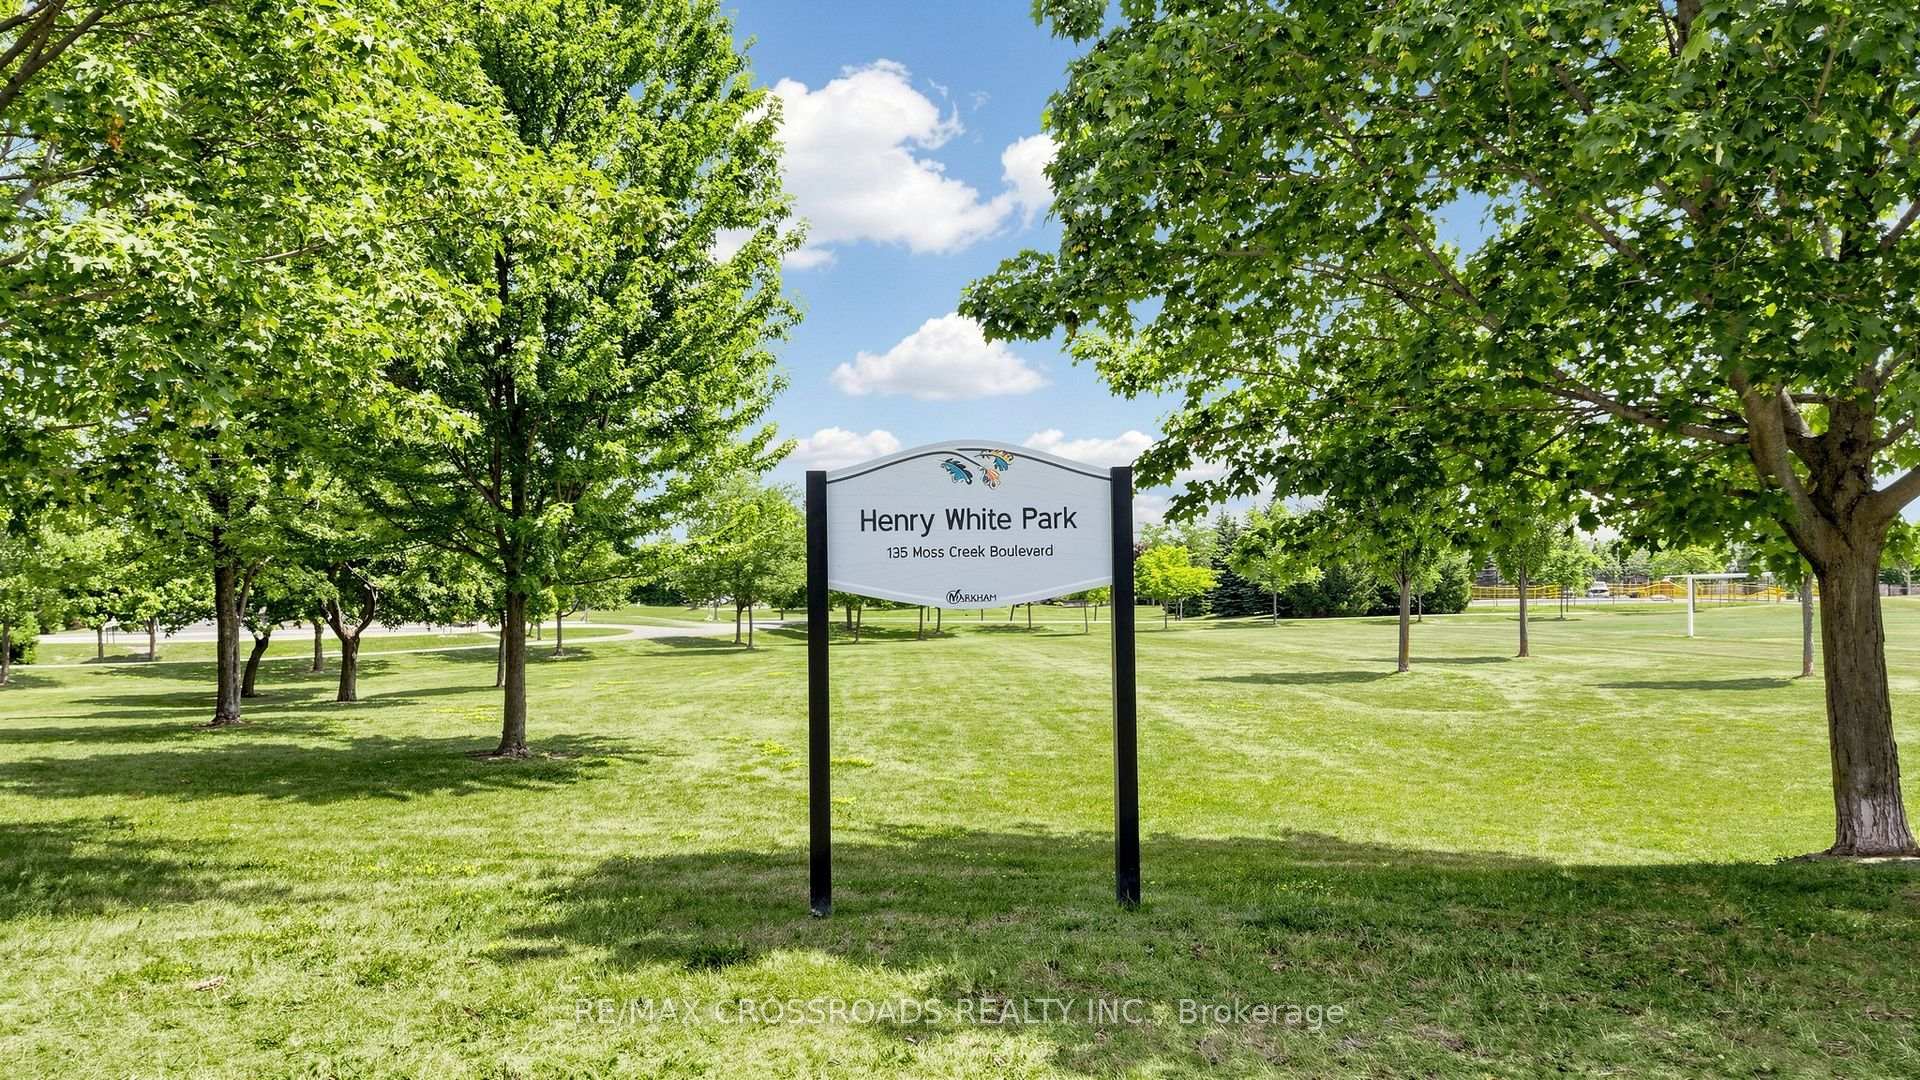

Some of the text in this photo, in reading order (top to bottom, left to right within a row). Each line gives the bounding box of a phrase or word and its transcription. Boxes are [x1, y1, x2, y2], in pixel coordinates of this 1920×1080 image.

[860, 506, 1078, 537] Henry White Park
[887, 544, 1054, 559] 135 Moss Creek Boulevard
[946, 589, 997, 604] MARKHAM
